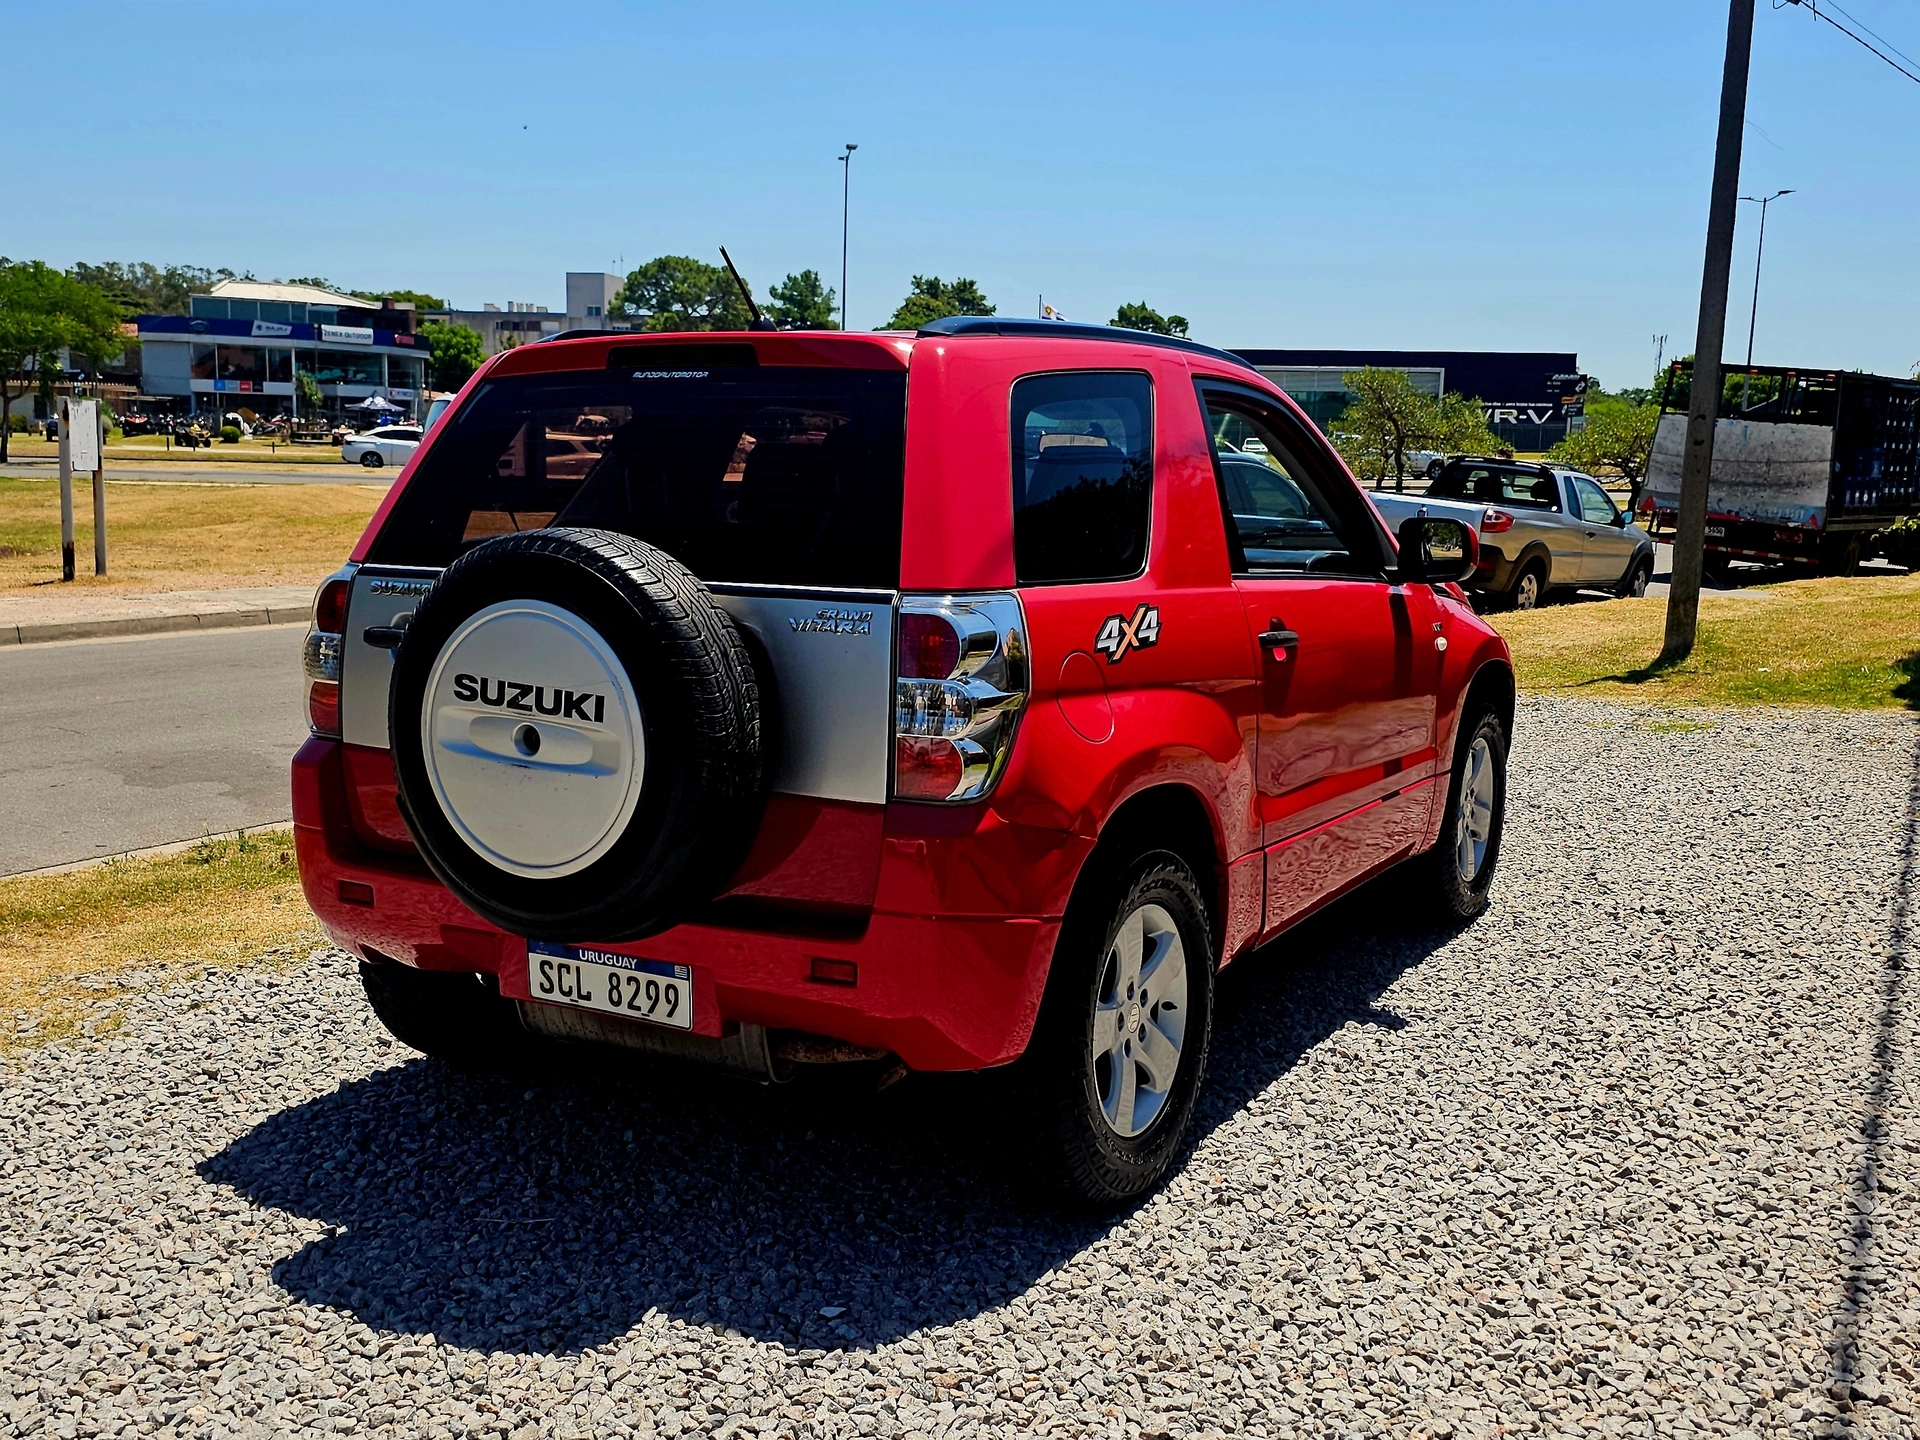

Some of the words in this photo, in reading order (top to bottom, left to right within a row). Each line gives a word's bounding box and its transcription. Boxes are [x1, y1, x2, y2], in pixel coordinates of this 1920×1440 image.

[370, 580, 431, 597] SUZUK
[817, 608, 873, 621] GRAND
[788, 617, 871, 635] VITARA
[453, 673, 605, 723] SUZUKI
[579, 949, 638, 970] URUGUAY
[539, 959, 592, 1002] SCL
[608, 971, 680, 1019] 8299
